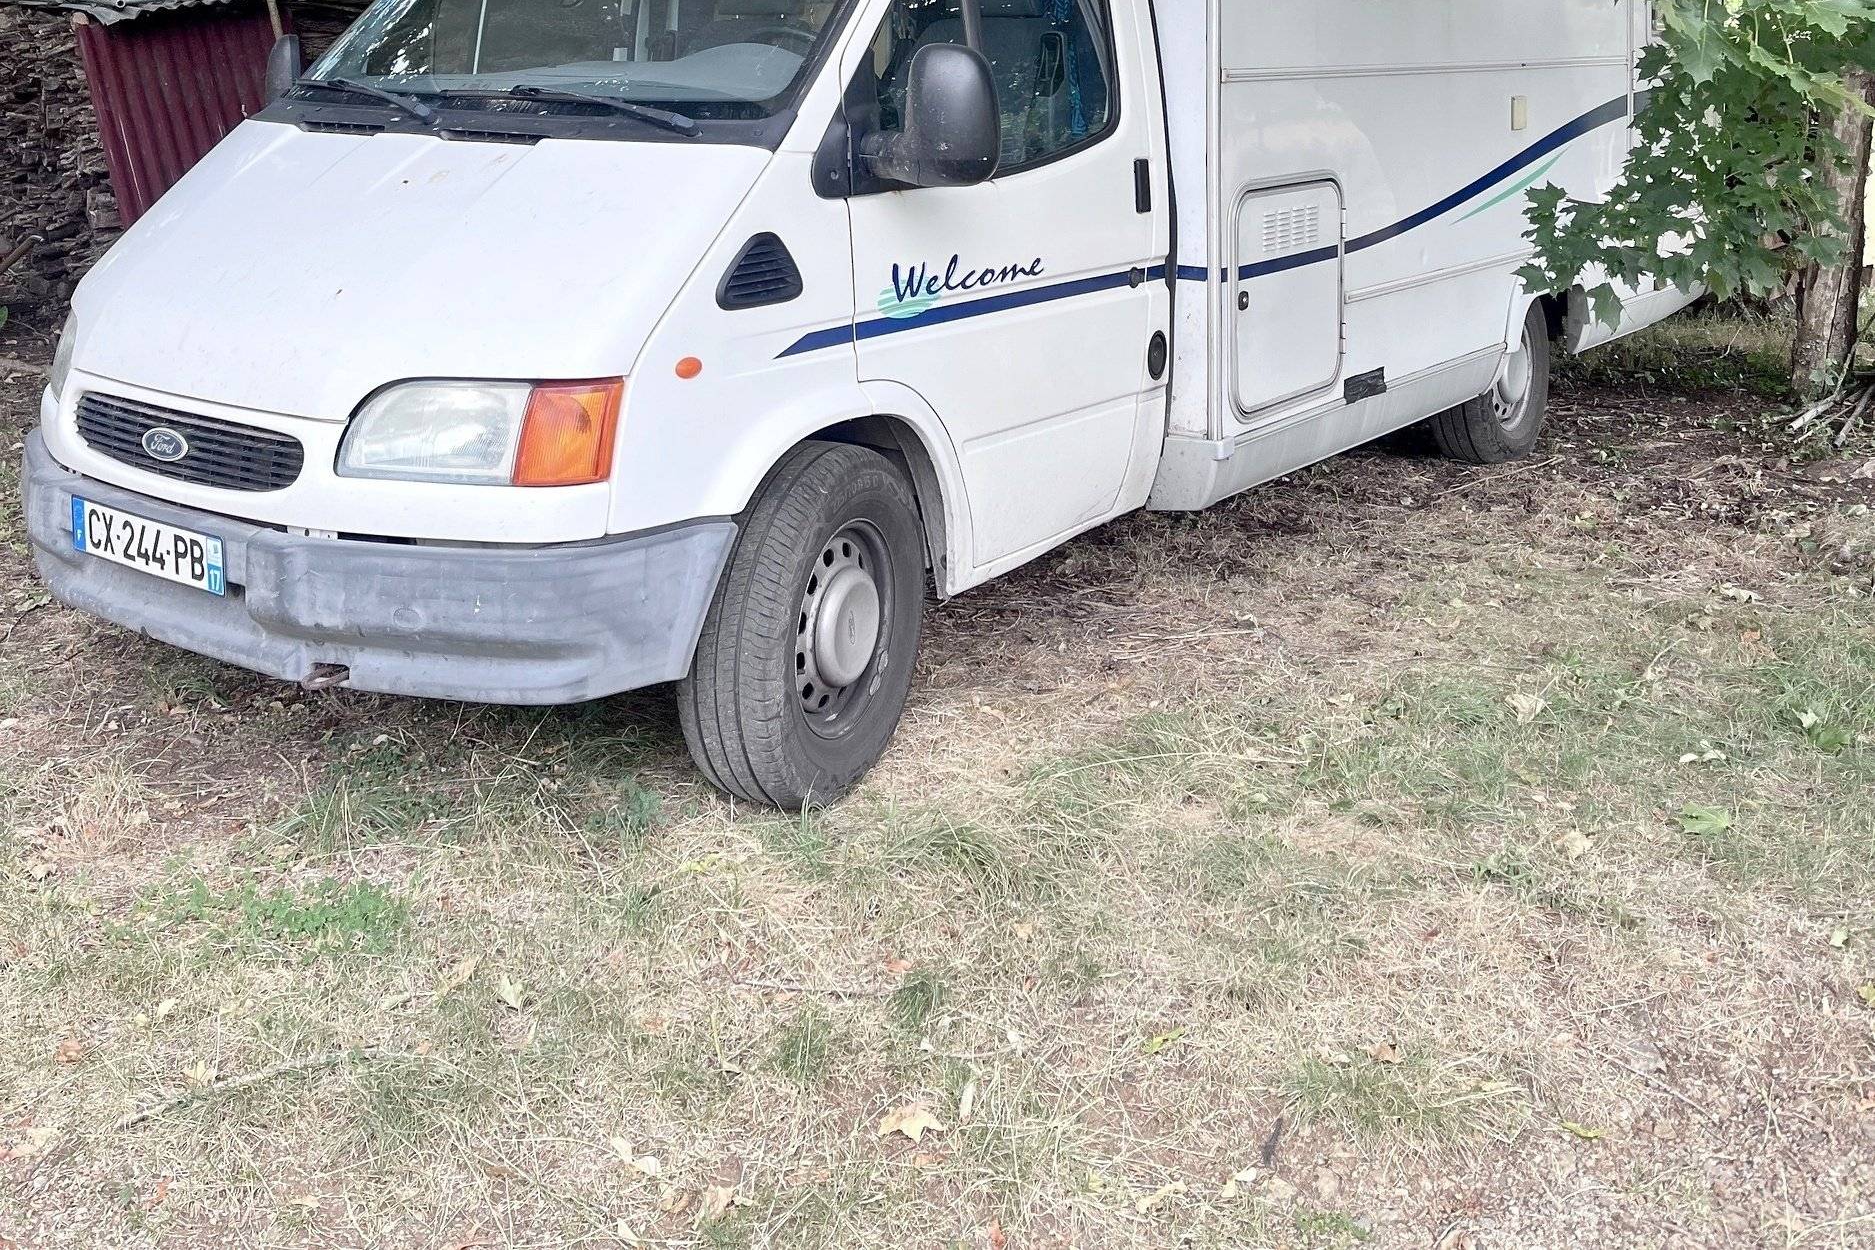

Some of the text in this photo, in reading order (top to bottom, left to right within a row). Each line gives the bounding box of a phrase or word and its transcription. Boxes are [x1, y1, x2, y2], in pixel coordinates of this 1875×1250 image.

[892, 253, 1044, 302] Welcome
[150, 433, 176, 454] Ford
[88, 508, 205, 581] CX-244-PB
[209, 568, 221, 592] 17
